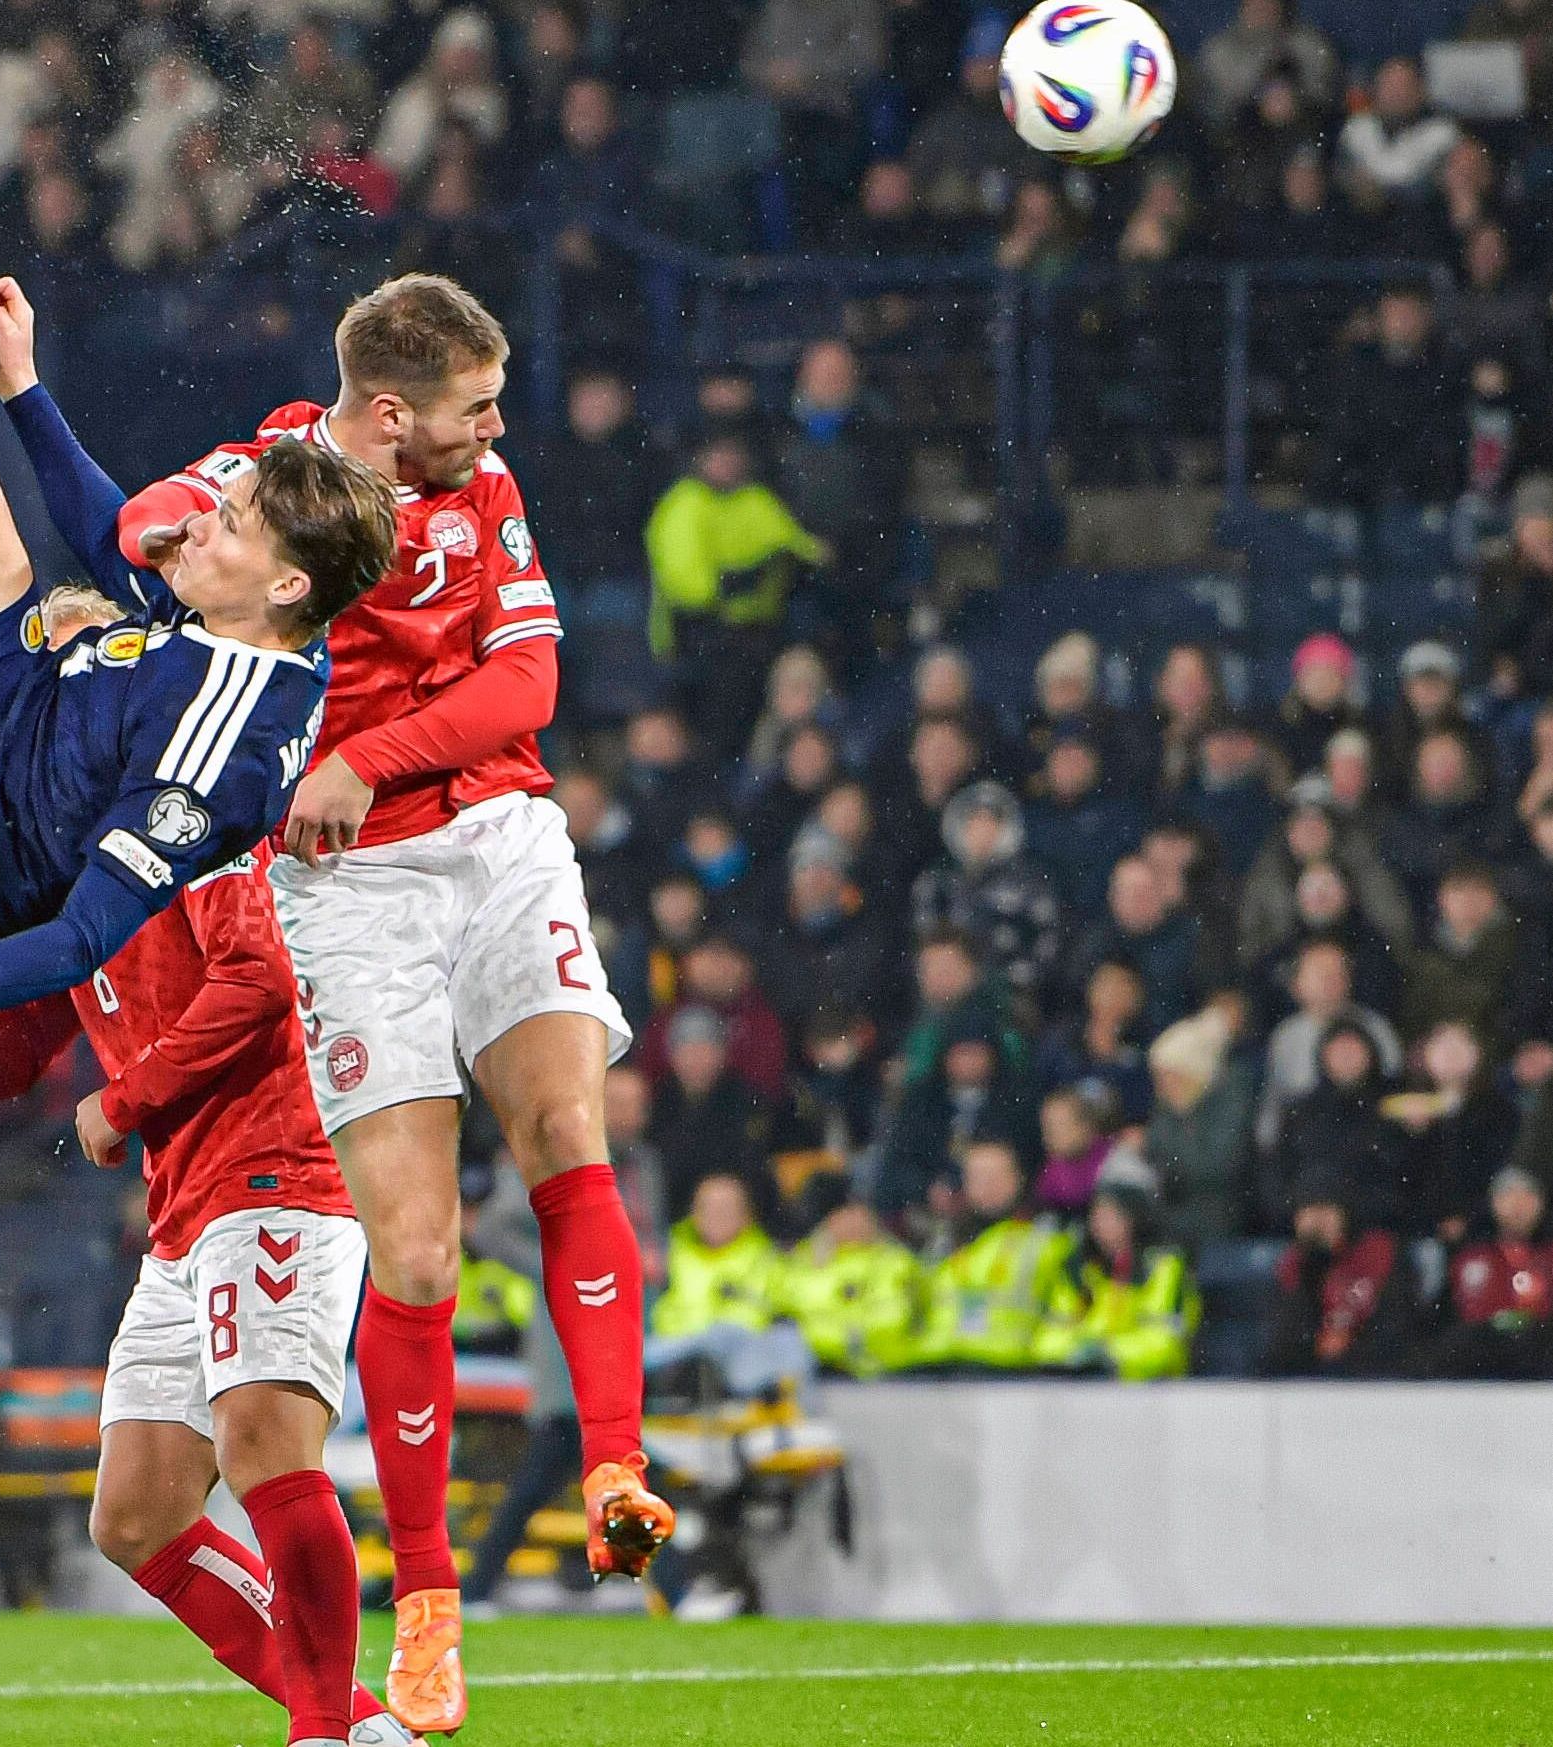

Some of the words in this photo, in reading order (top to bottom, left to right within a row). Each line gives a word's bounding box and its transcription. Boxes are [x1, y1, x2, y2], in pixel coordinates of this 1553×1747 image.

[549, 921, 591, 990] 2
[208, 1282, 239, 1363] 8
[240, 1579, 270, 1609] DAN
